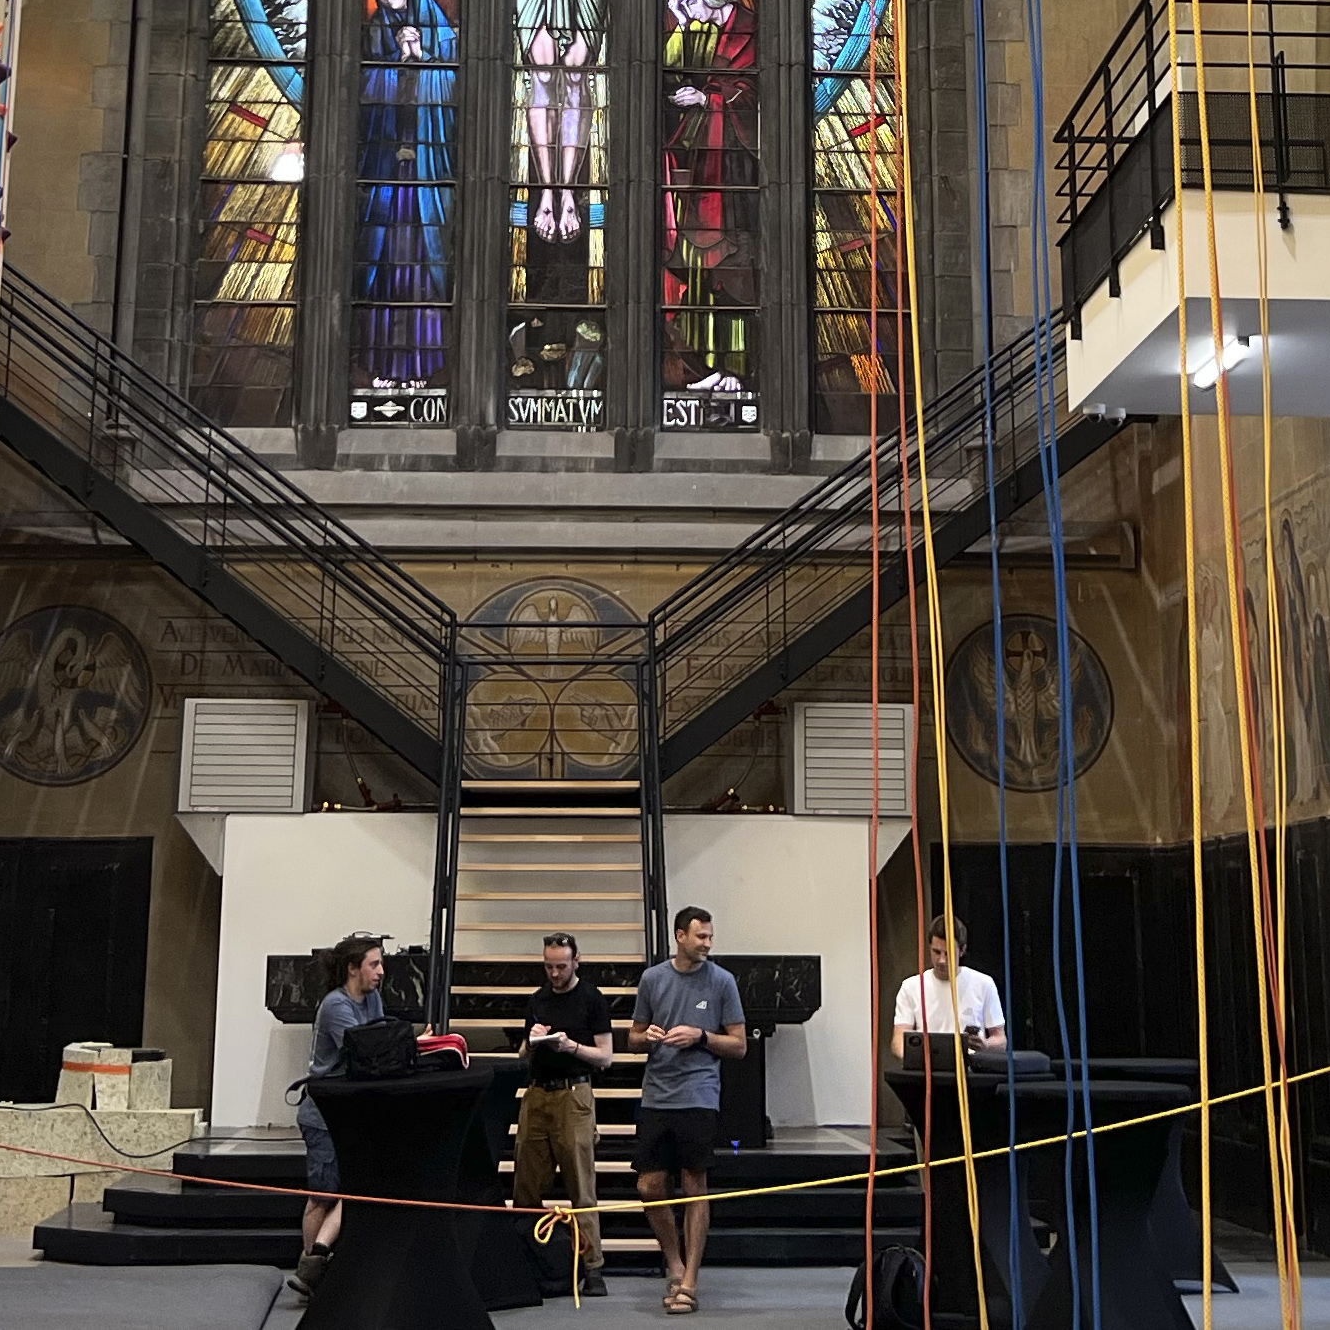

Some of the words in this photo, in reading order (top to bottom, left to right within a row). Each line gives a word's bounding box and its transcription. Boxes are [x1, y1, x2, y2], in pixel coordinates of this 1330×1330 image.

[410, 397, 447, 422] CON
[663, 399, 700, 426] EST
[222, 654, 296, 677] MARI
